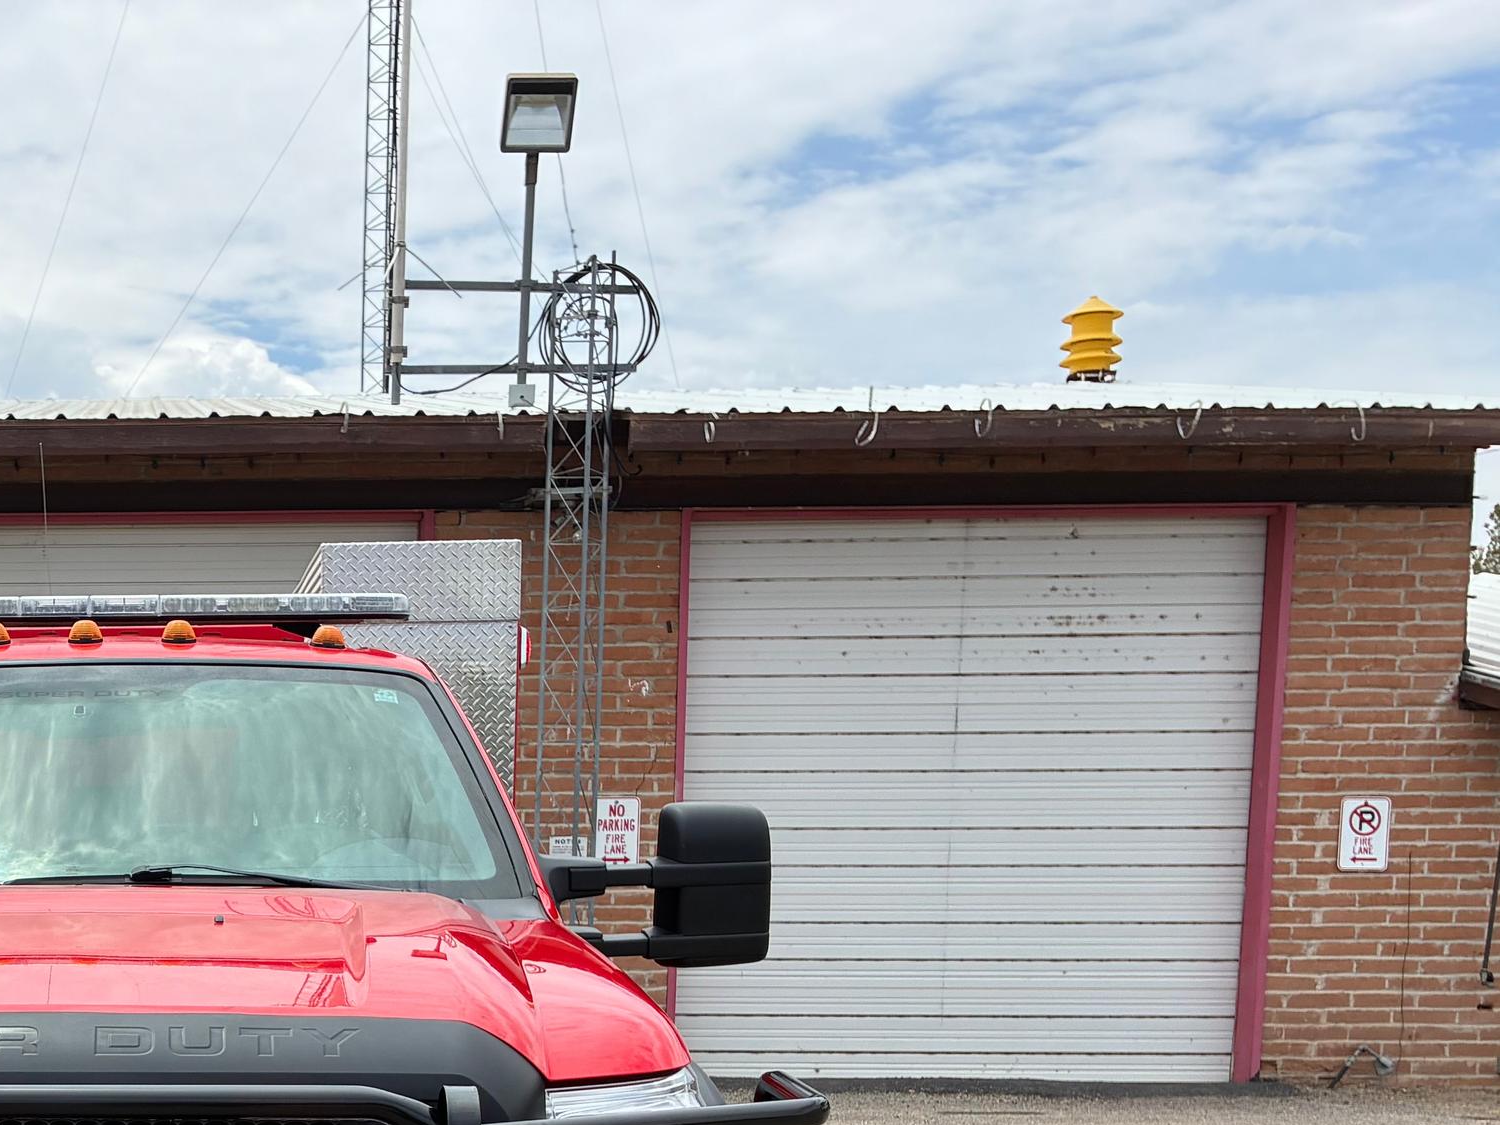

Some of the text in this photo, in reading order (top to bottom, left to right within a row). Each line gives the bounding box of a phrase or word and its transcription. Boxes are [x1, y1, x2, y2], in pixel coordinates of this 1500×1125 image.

[609, 804, 625, 817] NO
[597, 819, 635, 832] PARKING
[605, 834, 626, 843] FIRE
[1354, 837, 1373, 846] FIRE
[604, 844, 627, 855] LANE
[1352, 846, 1373, 855] LANE
[94, 1025, 360, 1057] DUTY
